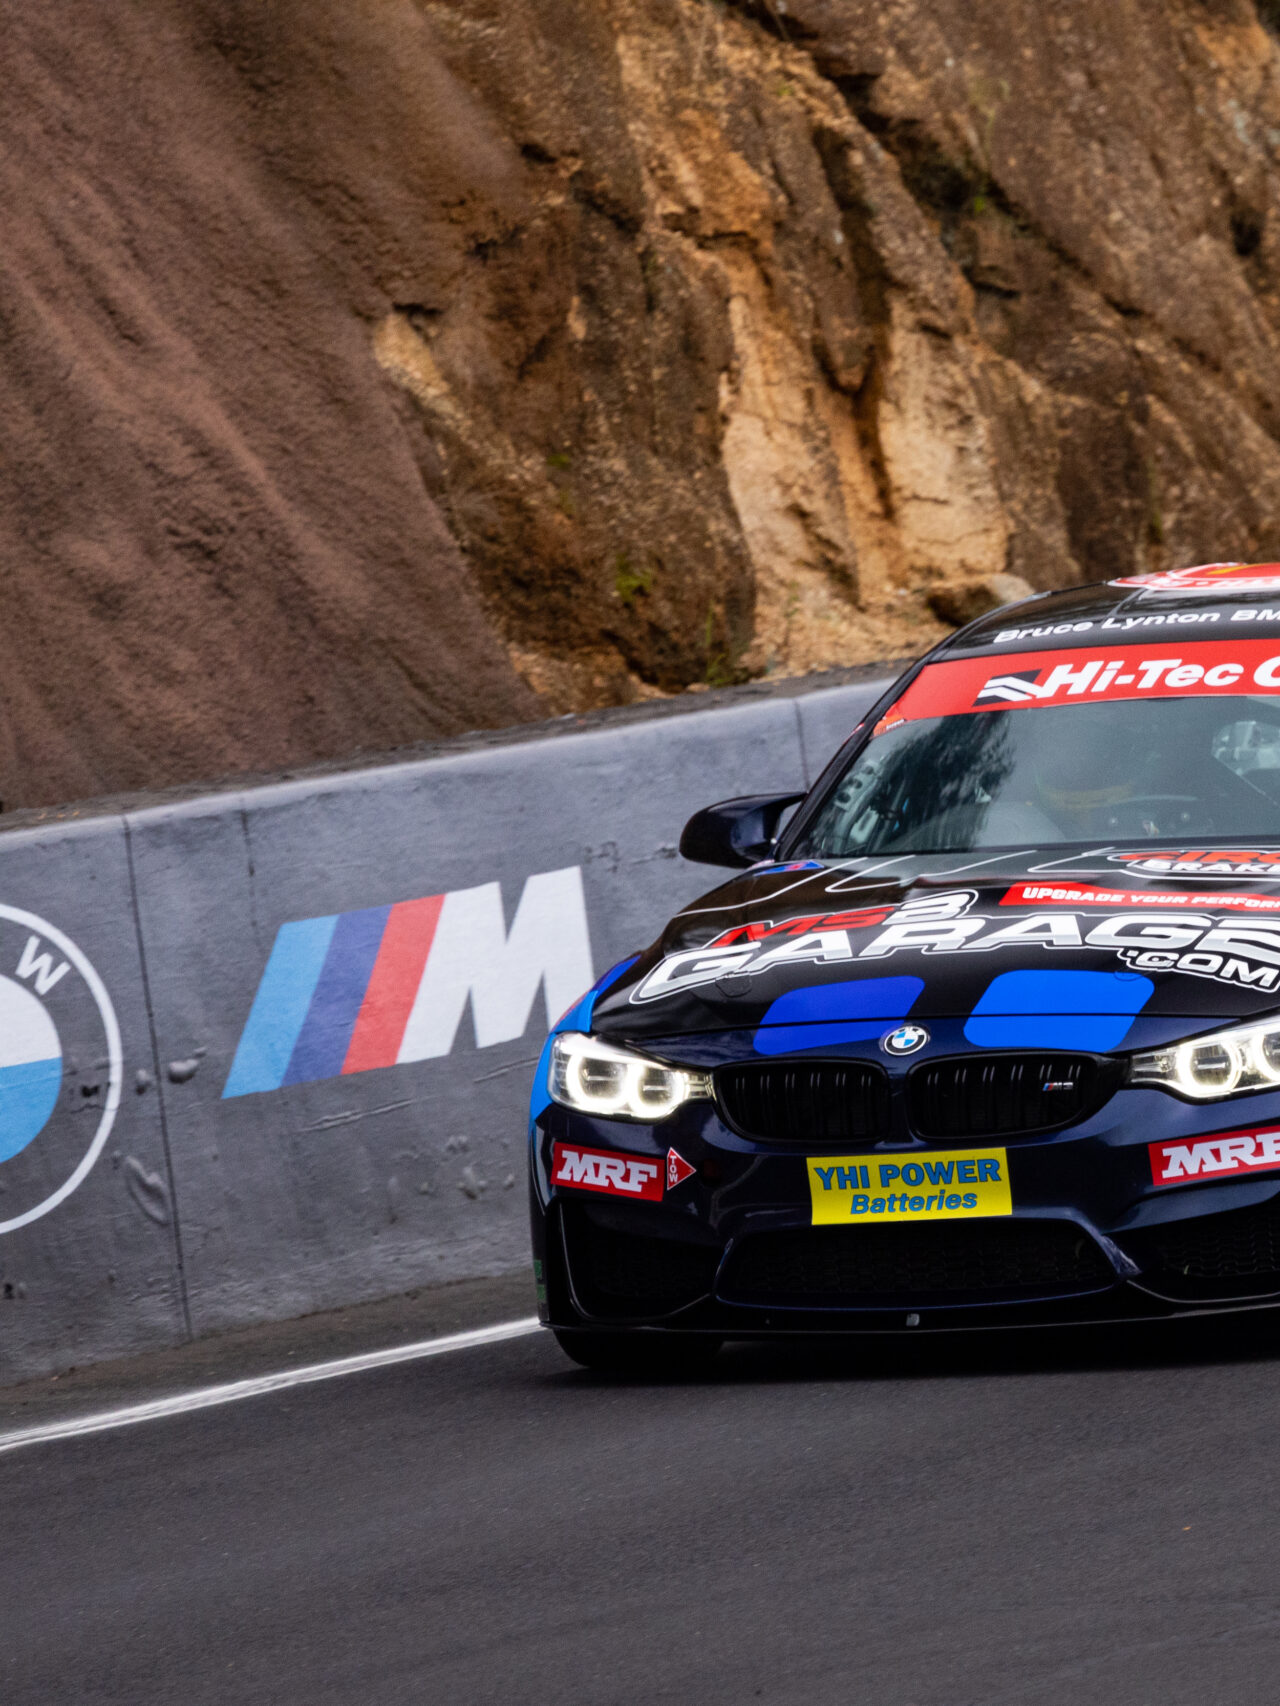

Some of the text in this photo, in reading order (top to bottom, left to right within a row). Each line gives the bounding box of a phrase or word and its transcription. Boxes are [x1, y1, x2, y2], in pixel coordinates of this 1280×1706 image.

[993, 621, 1094, 644] Bruce
[1101, 612, 1221, 630] Lynton
[1036, 658, 1249, 699] Hi-Tec
[1022, 887, 1125, 903] UPGRADE
[1130, 895, 1189, 904] YOUR
[557, 1150, 658, 1192] MRF
[669, 1155, 678, 1183] TOW
[814, 1158, 1003, 1191] YHI POWER
[850, 1189, 978, 1216] Batteries
